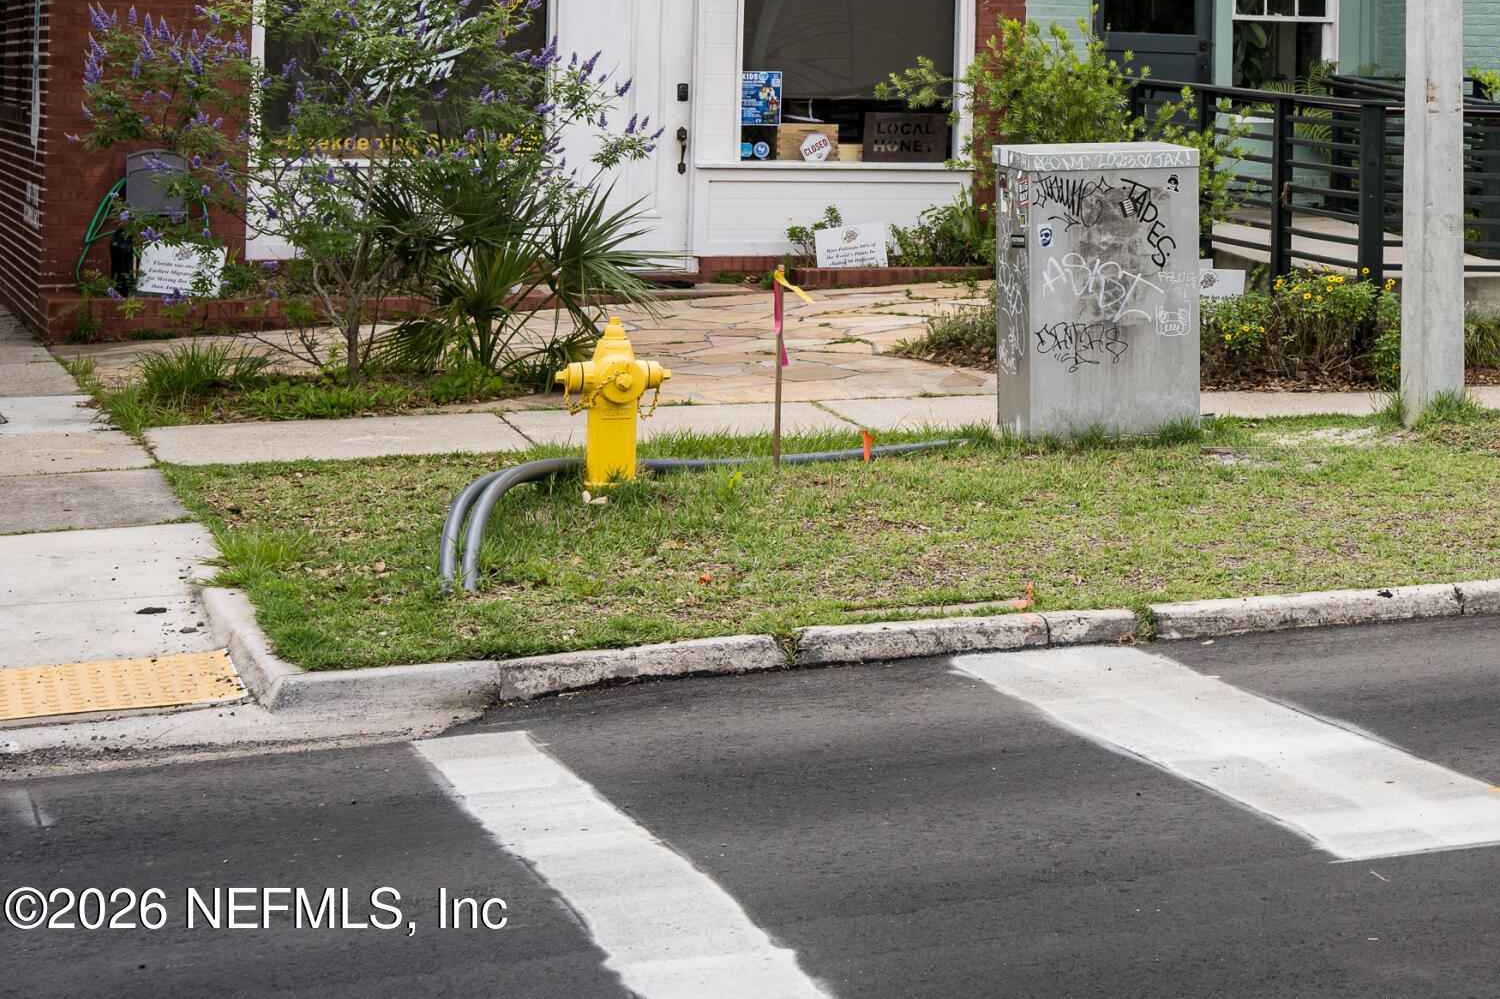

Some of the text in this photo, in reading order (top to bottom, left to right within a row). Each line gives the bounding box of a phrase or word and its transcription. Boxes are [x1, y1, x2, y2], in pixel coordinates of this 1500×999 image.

[877, 123, 933, 136] LOCAL
[803, 138, 828, 157] CLOSED
[873, 139, 936, 153] HONEY
